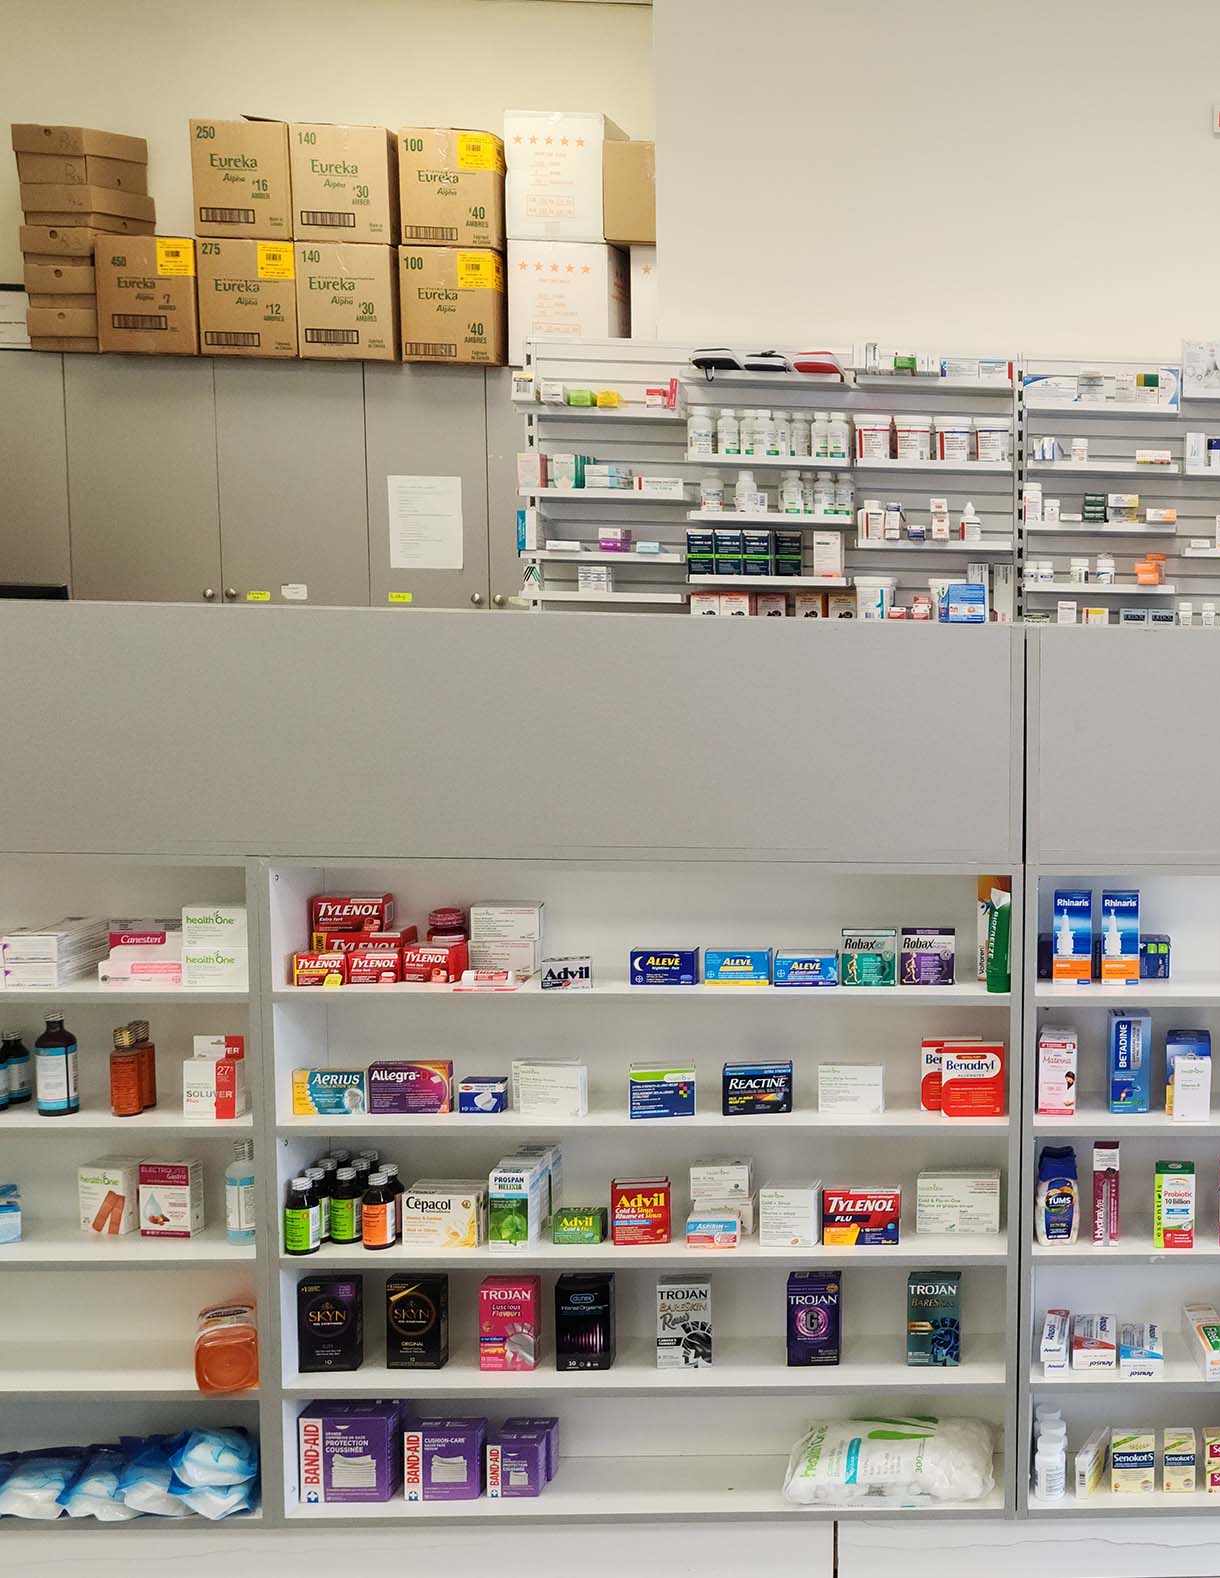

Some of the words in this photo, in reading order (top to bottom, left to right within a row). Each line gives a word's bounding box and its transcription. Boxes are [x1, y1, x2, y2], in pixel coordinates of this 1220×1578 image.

[196, 126, 216, 139] 250
[298, 132, 317, 146] 140
[403, 138, 424, 152] 100
[209, 154, 258, 168] Eureka
[310, 159, 358, 175] Eureka
[417, 170, 459, 185] Eureka
[323, 178, 346, 190] Alpha
[436, 187, 457, 197] Alpha
[465, 220, 489, 229] AMBRES
[201, 242, 220, 255] 275
[111, 256, 127, 266] 450
[302, 250, 321, 263] 140
[403, 256, 424, 271] 100
[117, 277, 156, 290] Eureka
[214, 279, 260, 293] Eureka
[308, 276, 355, 292] Eureka
[417, 287, 458, 301] Eureka
[330, 295, 353, 306] Alpha
[436, 304, 457, 314] Alpha
[464, 336, 487, 344] AMBRES
[1056, 898, 1090, 907] Rhinaris
[1104, 899, 1138, 907] Rhinaris
[318, 902, 380, 917] TYLENOL
[120, 934, 161, 945] Canesten
[988, 910, 999, 959] BIOFREEZE
[844, 938, 876, 951] Robax
[903, 937, 935, 950] Robax
[405, 952, 447, 963] TYLENOL
[646, 955, 681, 967] ALEVE
[723, 957, 753, 967] ALEVE
[977, 945, 985, 977] Voltaren
[298, 959, 342, 969] TYLENOL
[351, 959, 395, 969] TYLENOL
[790, 961, 821, 971] ALEVE
[544, 965, 590, 982] Advil
[1118, 1023, 1128, 1069] BETADINE
[946, 1059, 996, 1073] Benadryl
[312, 1071, 361, 1086] AERIUS
[729, 1076, 786, 1090] REACTINE
[186, 1090, 233, 1098] SOLUVER
[616, 1192, 665, 1207] Advil
[1163, 1190, 1193, 1198] Probiotic
[828, 1196, 895, 1213] TYLENOL
[1048, 1196, 1072, 1206] TUMS
[560, 1216, 593, 1227] Advil
[480, 1290, 531, 1301] TROJAN
[658, 1289, 708, 1300] TROJAN
[908, 1284, 958, 1295] TROJAN
[788, 1295, 838, 1305] TROJAN
[308, 1310, 346, 1322] SKYN
[394, 1309, 430, 1320] SKYN
[660, 1313, 691, 1331] Raw
[325, 1445, 364, 1453] COUSSINÉE
